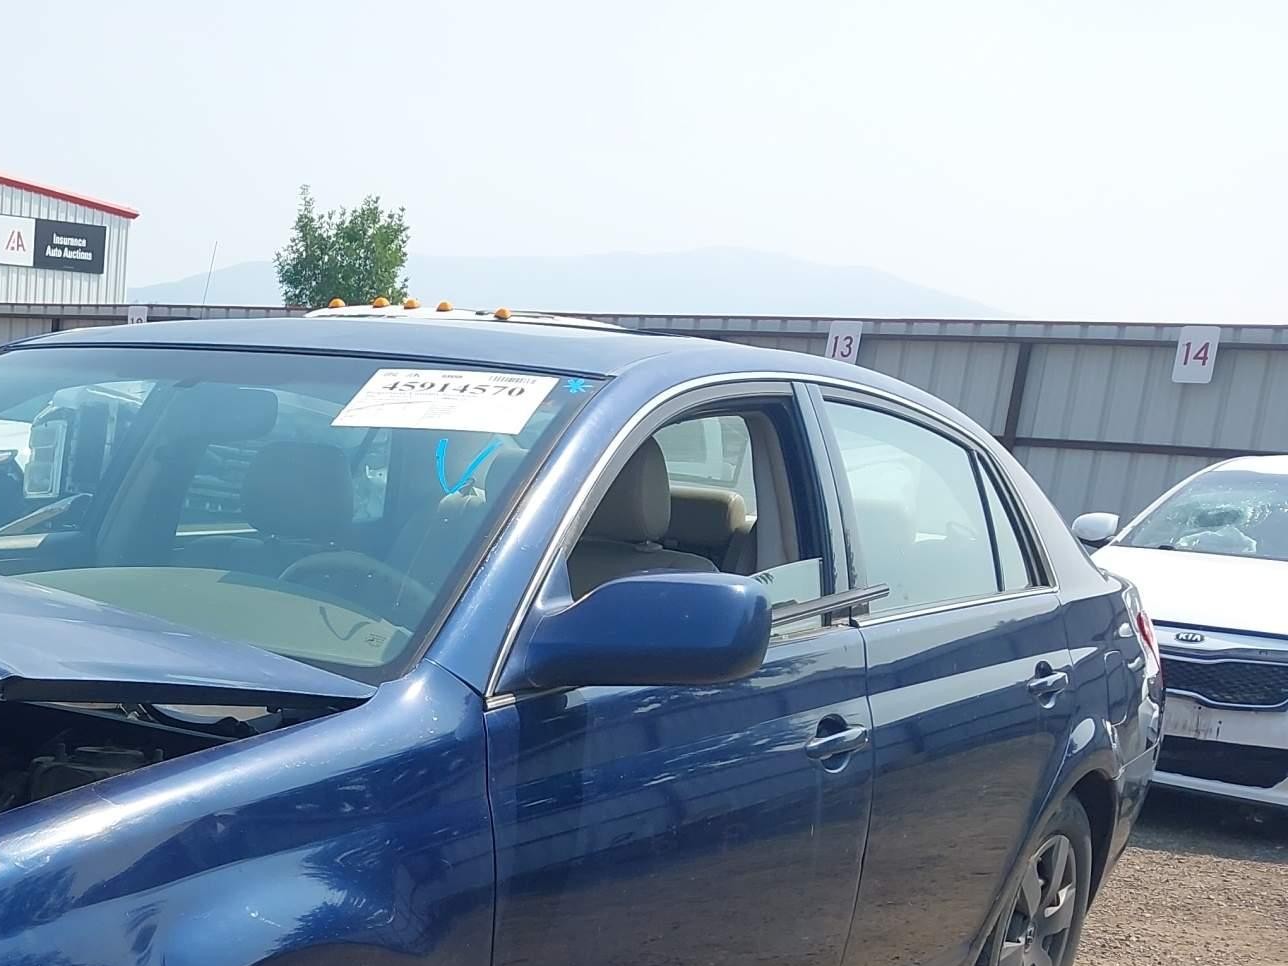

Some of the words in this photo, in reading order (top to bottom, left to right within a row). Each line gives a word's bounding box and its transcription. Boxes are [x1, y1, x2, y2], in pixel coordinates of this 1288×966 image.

[53, 233, 87, 247] Insurance
[45, 245, 62, 258] Auto
[63, 247, 92, 261] Auctions
[831, 335, 854, 359] 13
[1181, 341, 1211, 367] 14
[381, 379, 526, 398] 45914570
[1177, 632, 1202, 643] KIA
